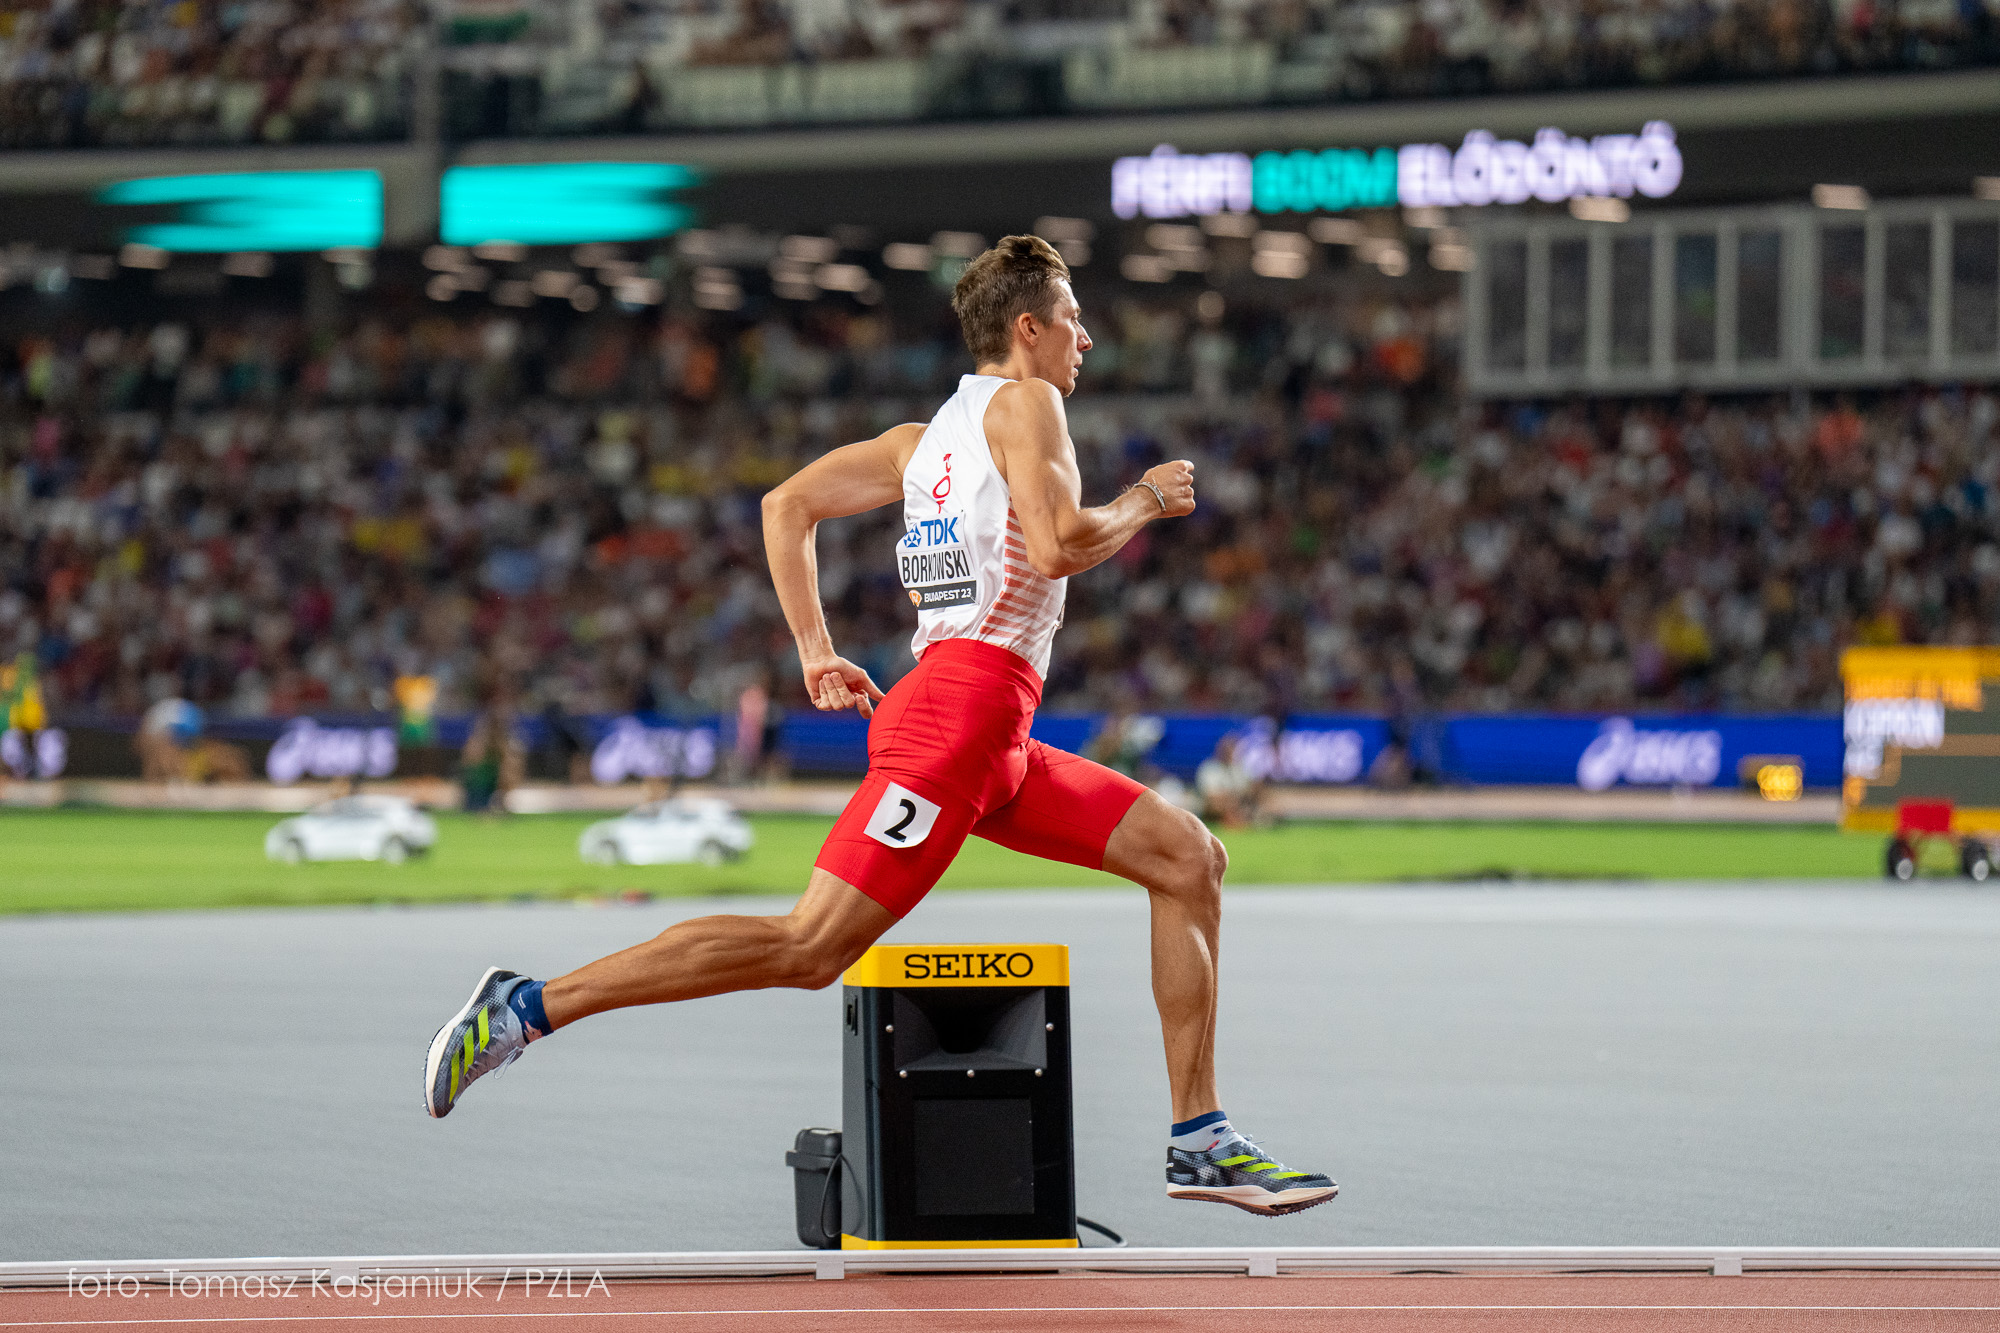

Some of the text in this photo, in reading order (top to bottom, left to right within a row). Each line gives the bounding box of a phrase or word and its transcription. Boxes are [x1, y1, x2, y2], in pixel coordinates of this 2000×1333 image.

[920, 516, 960, 547] TDK
[901, 549, 971, 584] BORKOWSKI
[960, 587, 972, 599] 23
[883, 798, 917, 843] 2
[904, 952, 1034, 980] SEIKO
